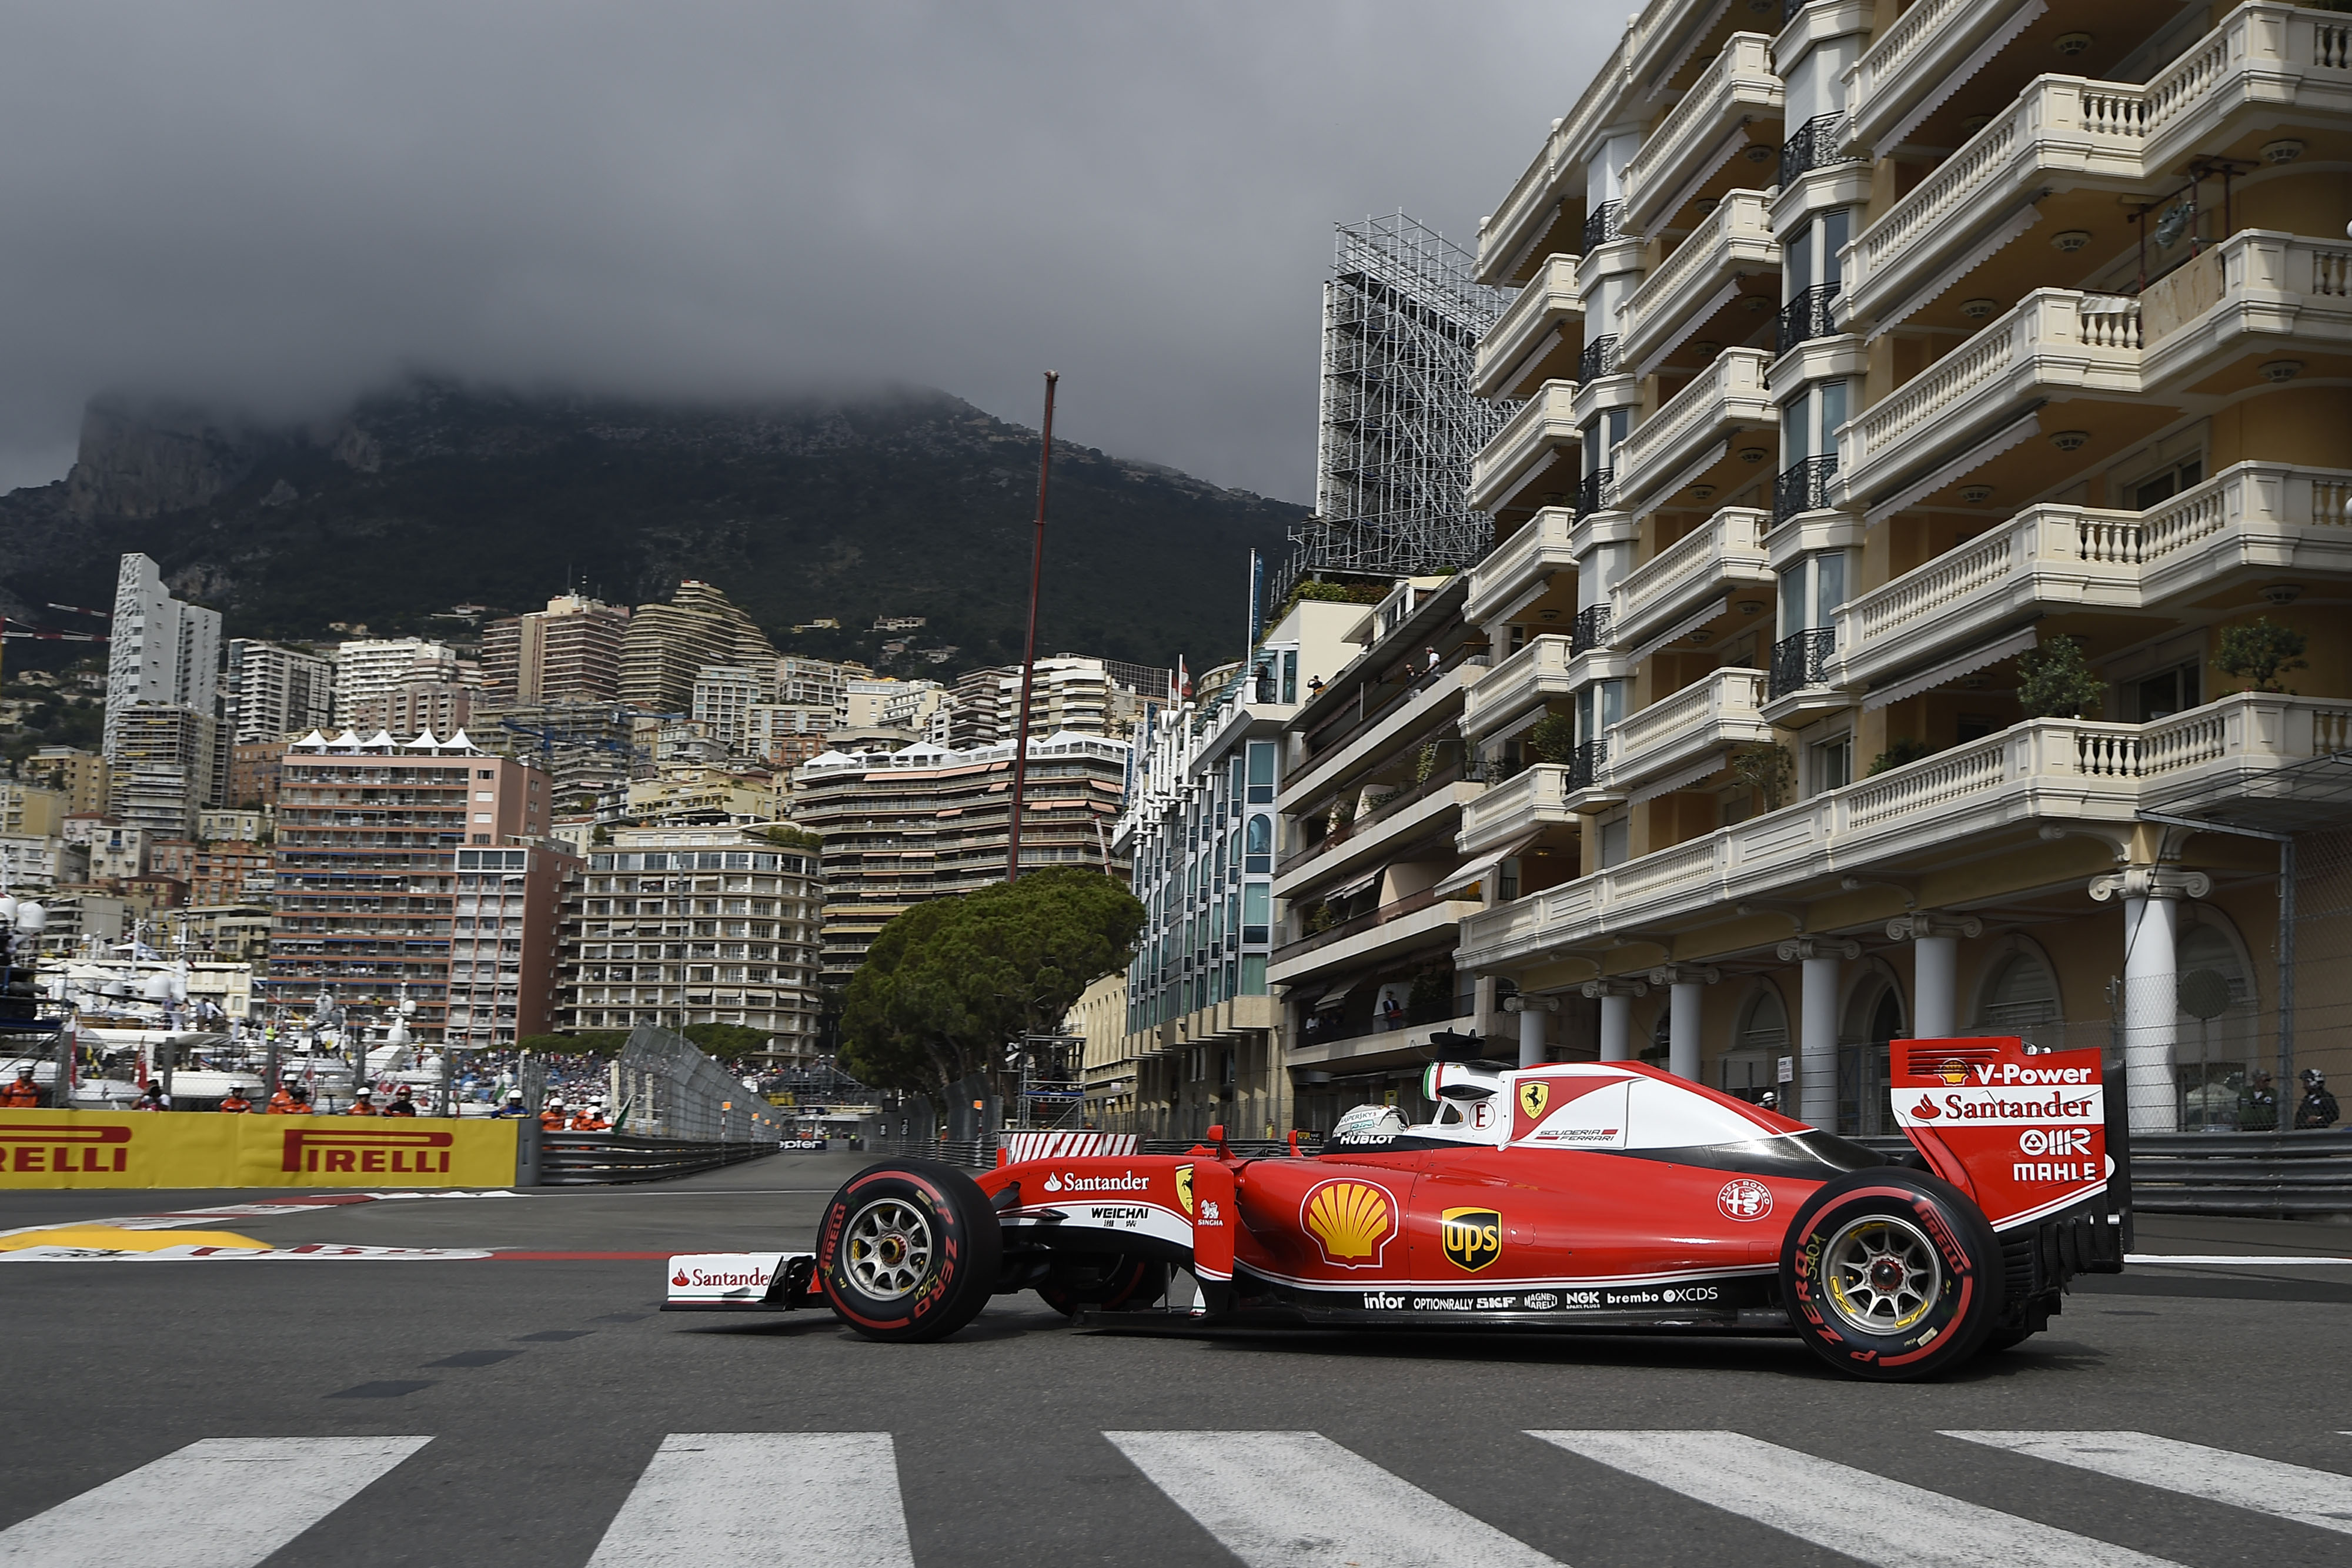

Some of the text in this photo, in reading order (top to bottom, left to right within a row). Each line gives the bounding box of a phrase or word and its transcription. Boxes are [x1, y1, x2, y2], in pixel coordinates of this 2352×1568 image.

[1974, 1064, 2092, 1085] V-Power
[1946, 1091, 2093, 1119] Santander
[282, 1129, 453, 1172] PIRELLI
[1339, 1135, 1396, 1145] HUBLOT
[1064, 1170, 1150, 1191] Santander
[2013, 1162, 2096, 1181] MAHLE
[1720, 1181, 1770, 1205] ALFA ROMEO
[936, 1206, 954, 1225] P
[1091, 1208, 1149, 1219] WEICHAI
[820, 1202, 847, 1269] PIRELLI
[1912, 1199, 1972, 1275] PIRELLI
[913, 1235, 958, 1319] ZERO
[1364, 1292, 1405, 1309] infor
[1476, 1296, 1516, 1309] SKF
[1566, 1291, 1600, 1305] NGK
[1607, 1291, 1659, 1303] brembo
[1795, 1248, 1877, 1362] P ZERO
